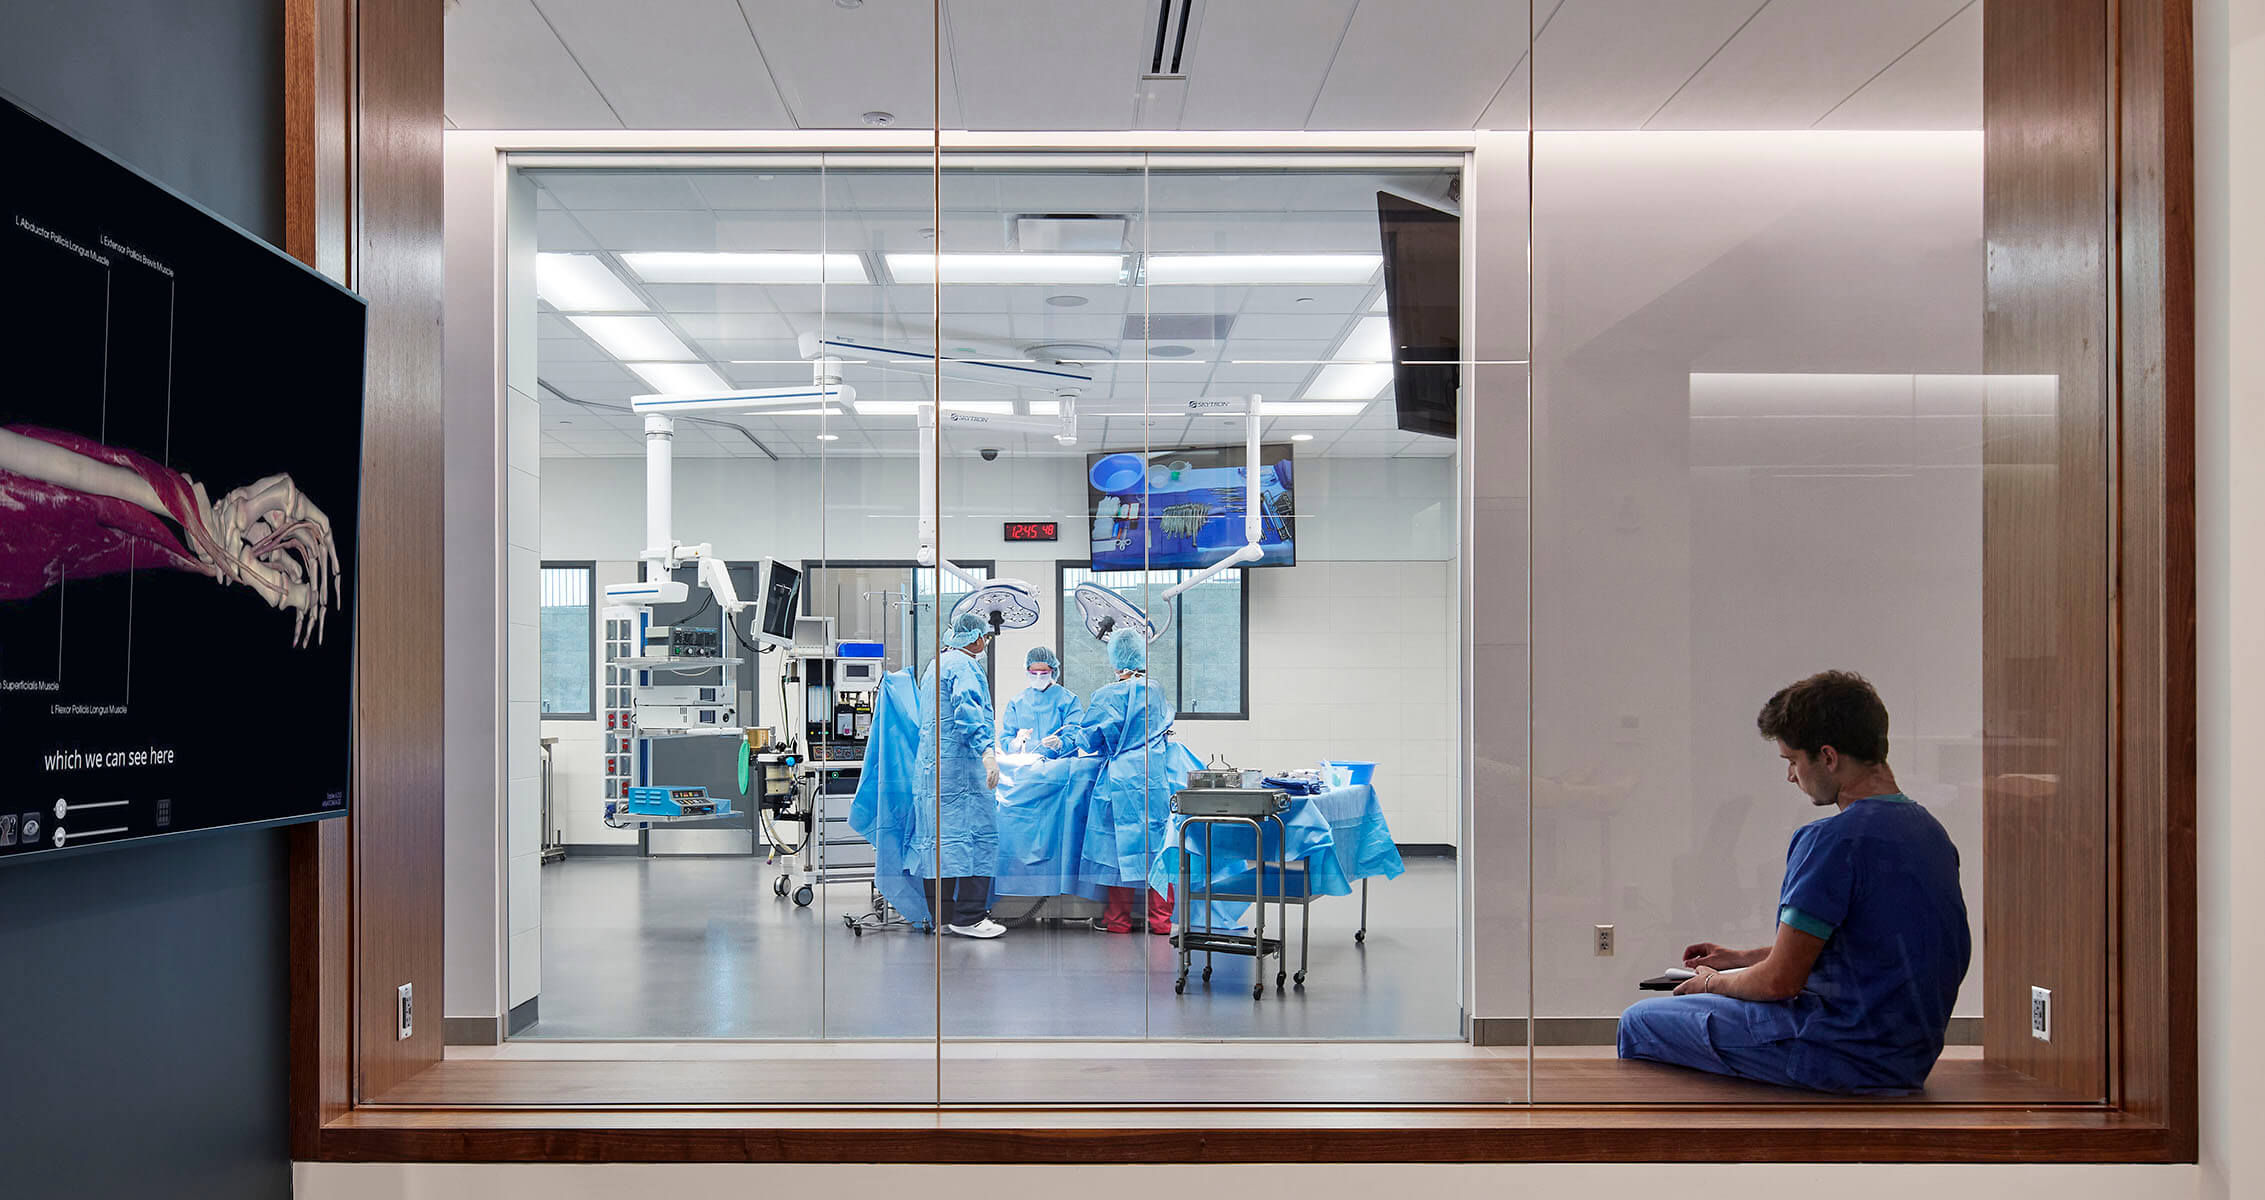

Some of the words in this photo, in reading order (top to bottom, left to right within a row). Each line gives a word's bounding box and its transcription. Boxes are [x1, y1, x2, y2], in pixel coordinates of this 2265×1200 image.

[69, 240, 90, 257] Longus
[90, 250, 110, 267] Muscle
[157, 261, 174, 277] Muscle
[1012, 525, 1038, 539] 12:45
[1042, 524, 1054, 536] 48
[38, 680, 59, 691] Muscle
[89, 705, 108, 716] Longus
[109, 704, 127, 714] Muscle
[44, 749, 82, 771] which
[85, 752, 103, 769] we
[105, 751, 126, 768] can
[128, 750, 147, 766] see
[150, 746, 174, 765] here
